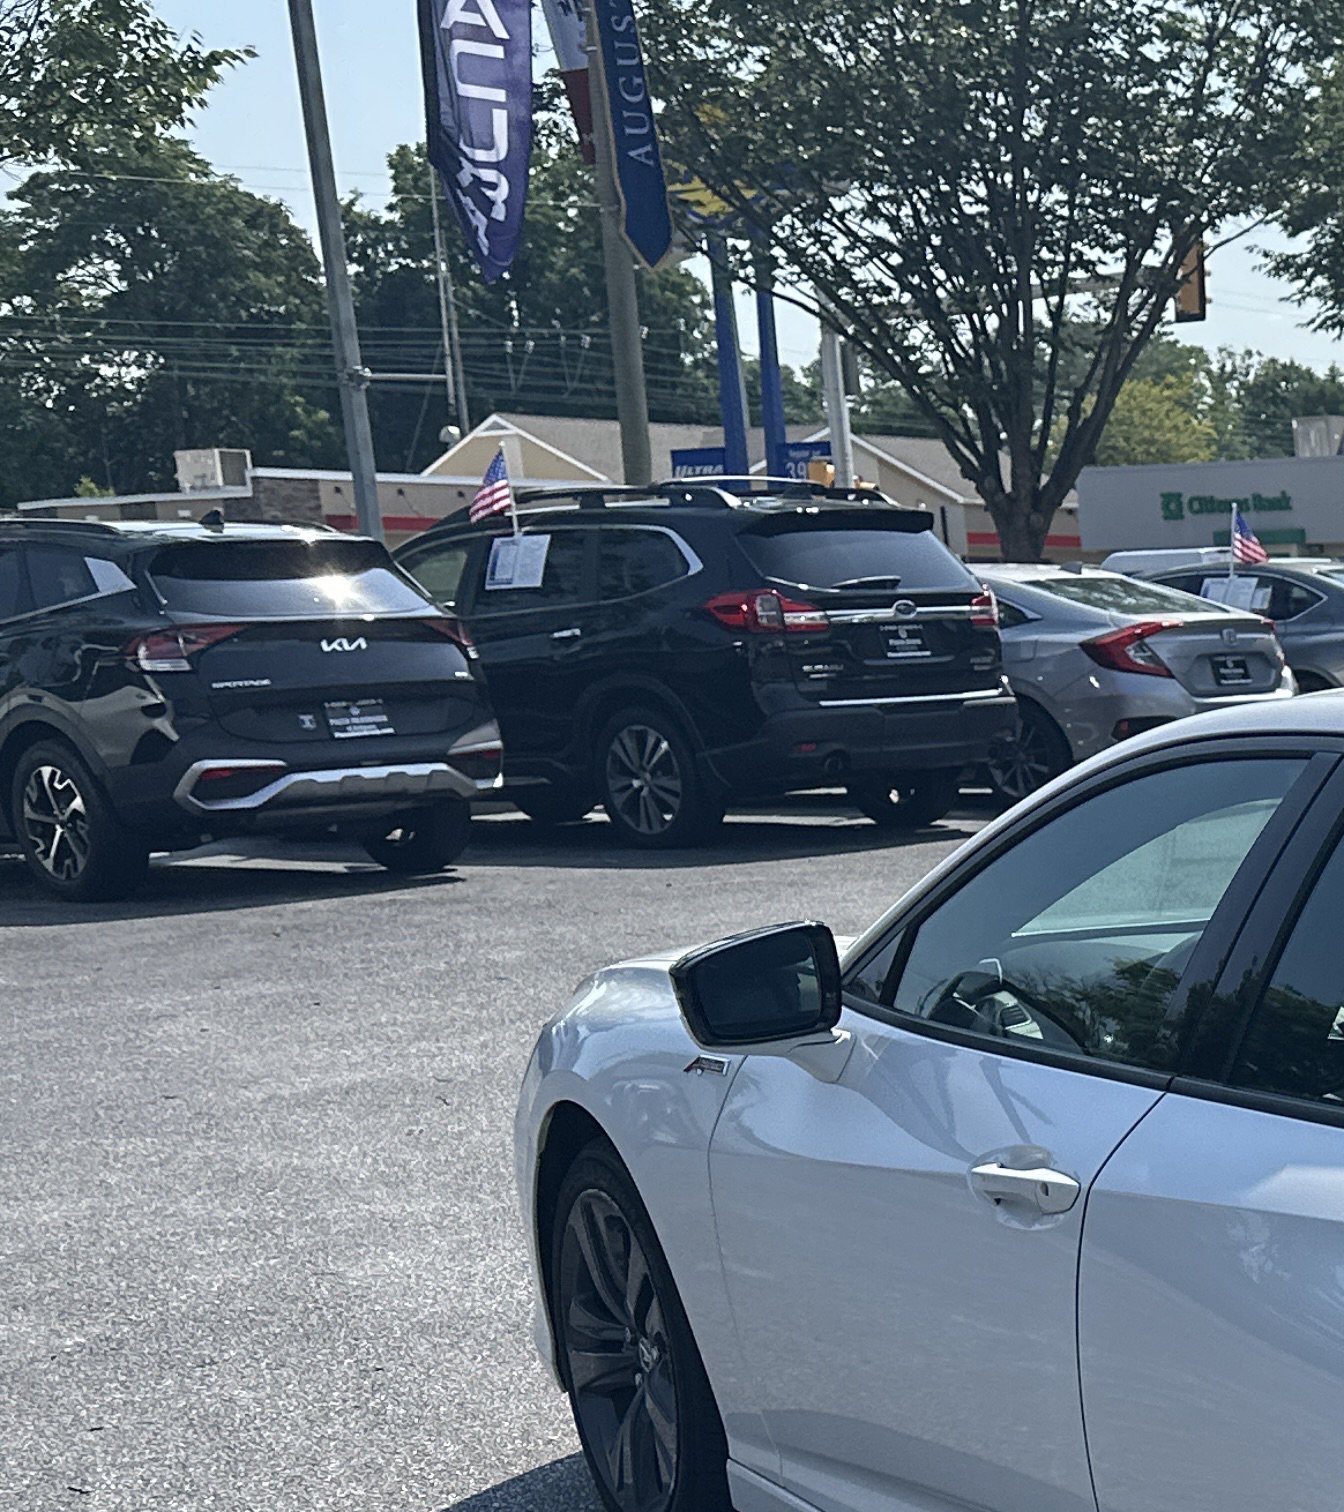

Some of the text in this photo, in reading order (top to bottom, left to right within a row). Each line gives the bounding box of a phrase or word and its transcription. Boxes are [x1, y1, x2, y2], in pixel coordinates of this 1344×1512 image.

[609, 0, 656, 168] AUGUS
[1251, 490, 1293, 512] Bank
[320, 636, 368, 652] KIA
